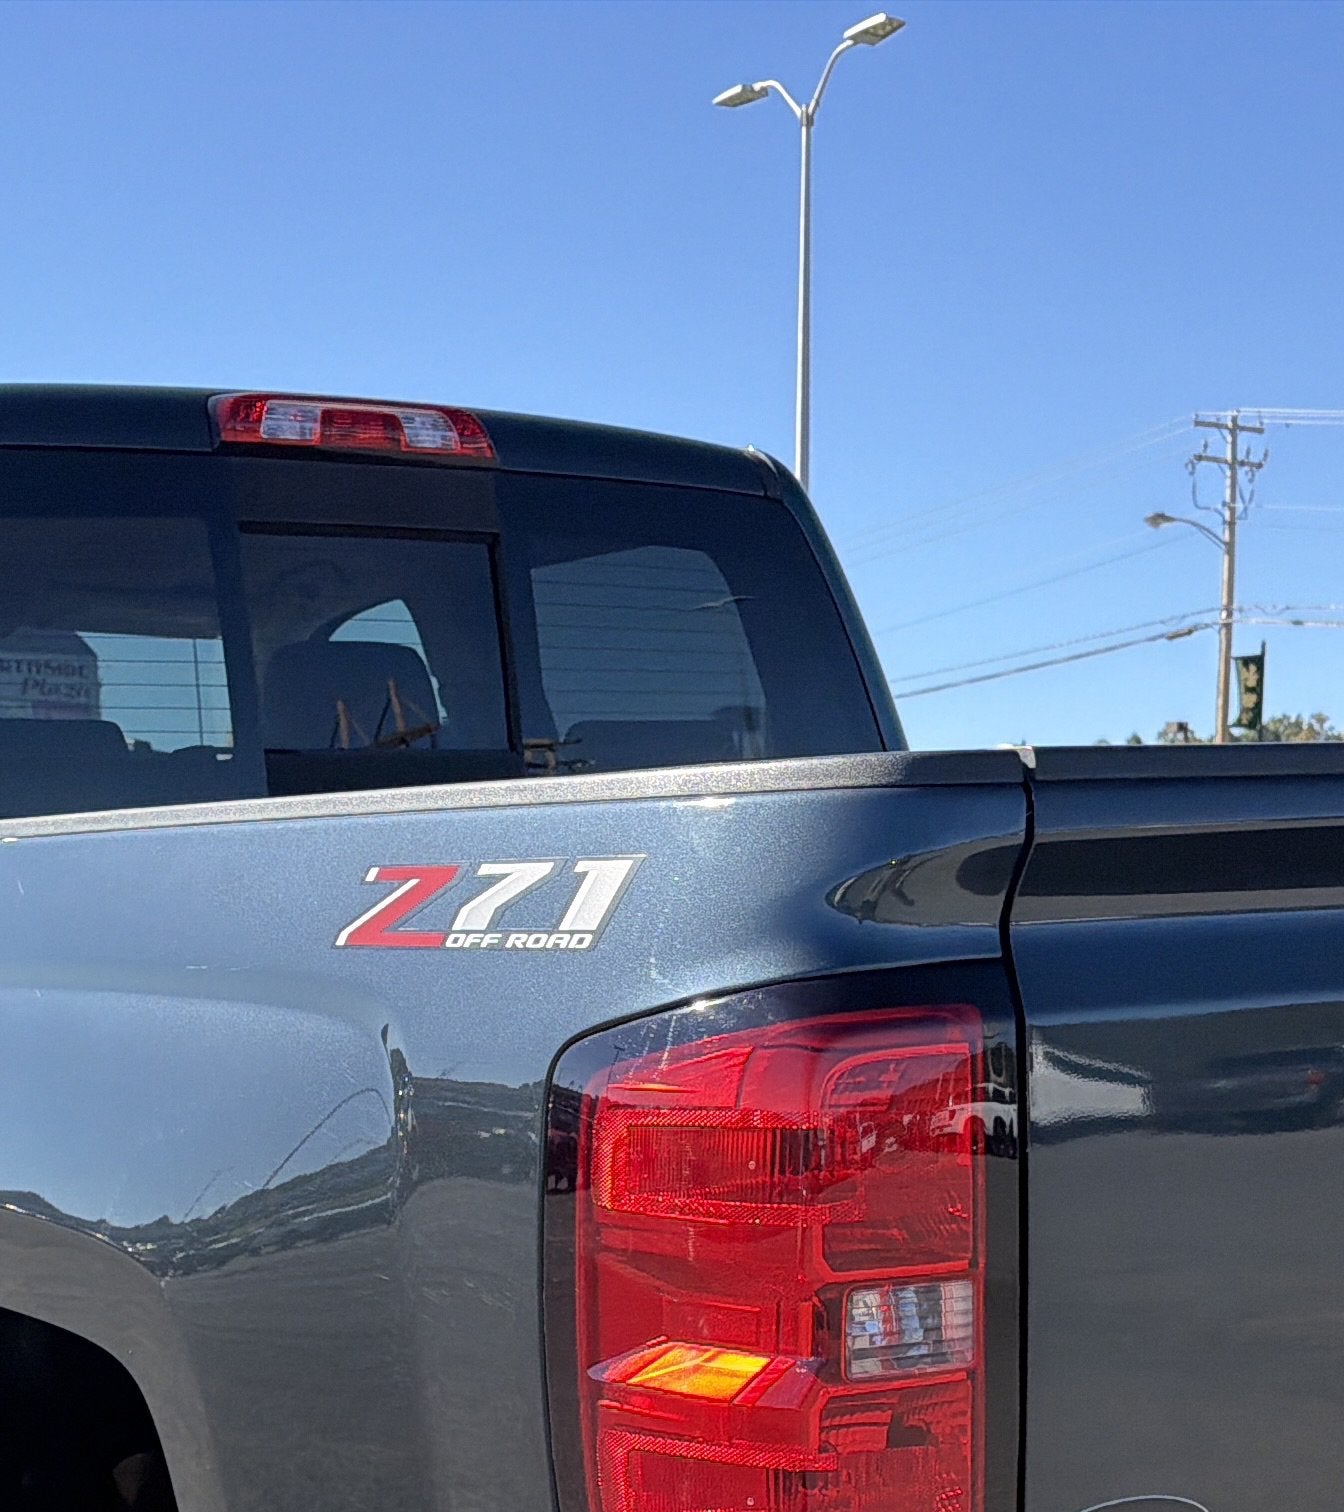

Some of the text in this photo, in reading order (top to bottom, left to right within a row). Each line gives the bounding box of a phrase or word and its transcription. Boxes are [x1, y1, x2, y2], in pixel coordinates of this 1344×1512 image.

[334, 854, 646, 949] Z71
[444, 932, 594, 949] OFF ROAD
